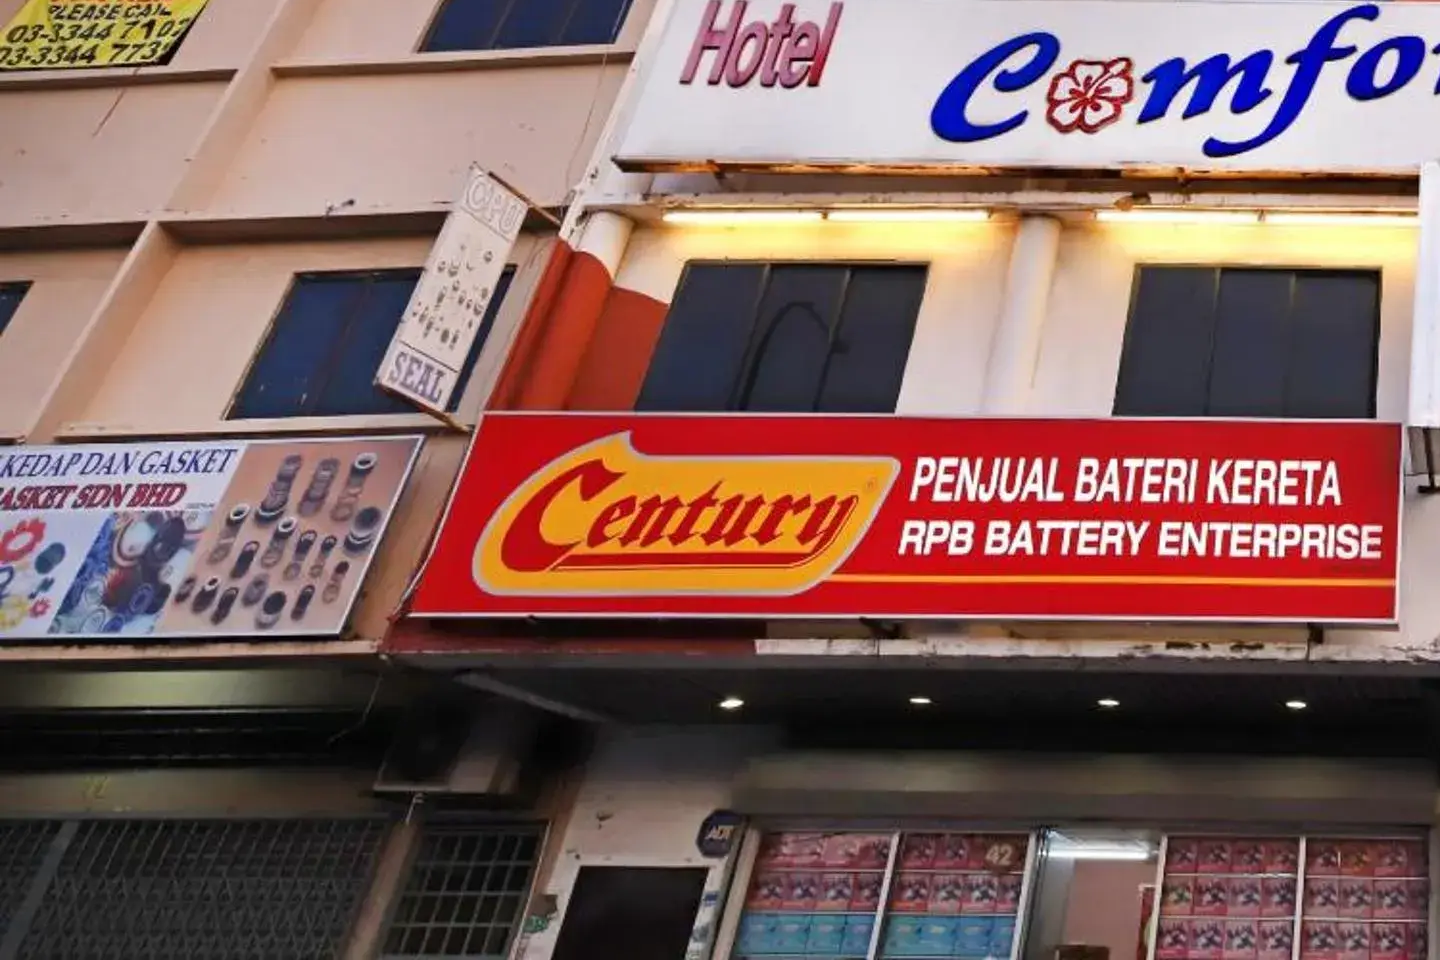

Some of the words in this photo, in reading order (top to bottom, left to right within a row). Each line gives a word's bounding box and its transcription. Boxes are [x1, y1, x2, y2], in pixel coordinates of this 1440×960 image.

[48, 4, 122, 22] PLEASE
[388, 350, 448, 403] SEAL
[80, 450, 141, 476] DAN
[137, 448, 238, 475] GASKET
[71, 482, 132, 510] SDN
[127, 481, 188, 508] BHD
[908, 456, 1065, 504] PENJUAL
[1072, 458, 1199, 504] BATERI
[1206, 459, 1343, 506] KERETA
[500, 457, 860, 572] Century
[898, 519, 976, 556] RPB
[983, 520, 1150, 558] BATTERY
[1157, 522, 1385, 560] ENTERPRISE
[985, 843, 1013, 868] 42
